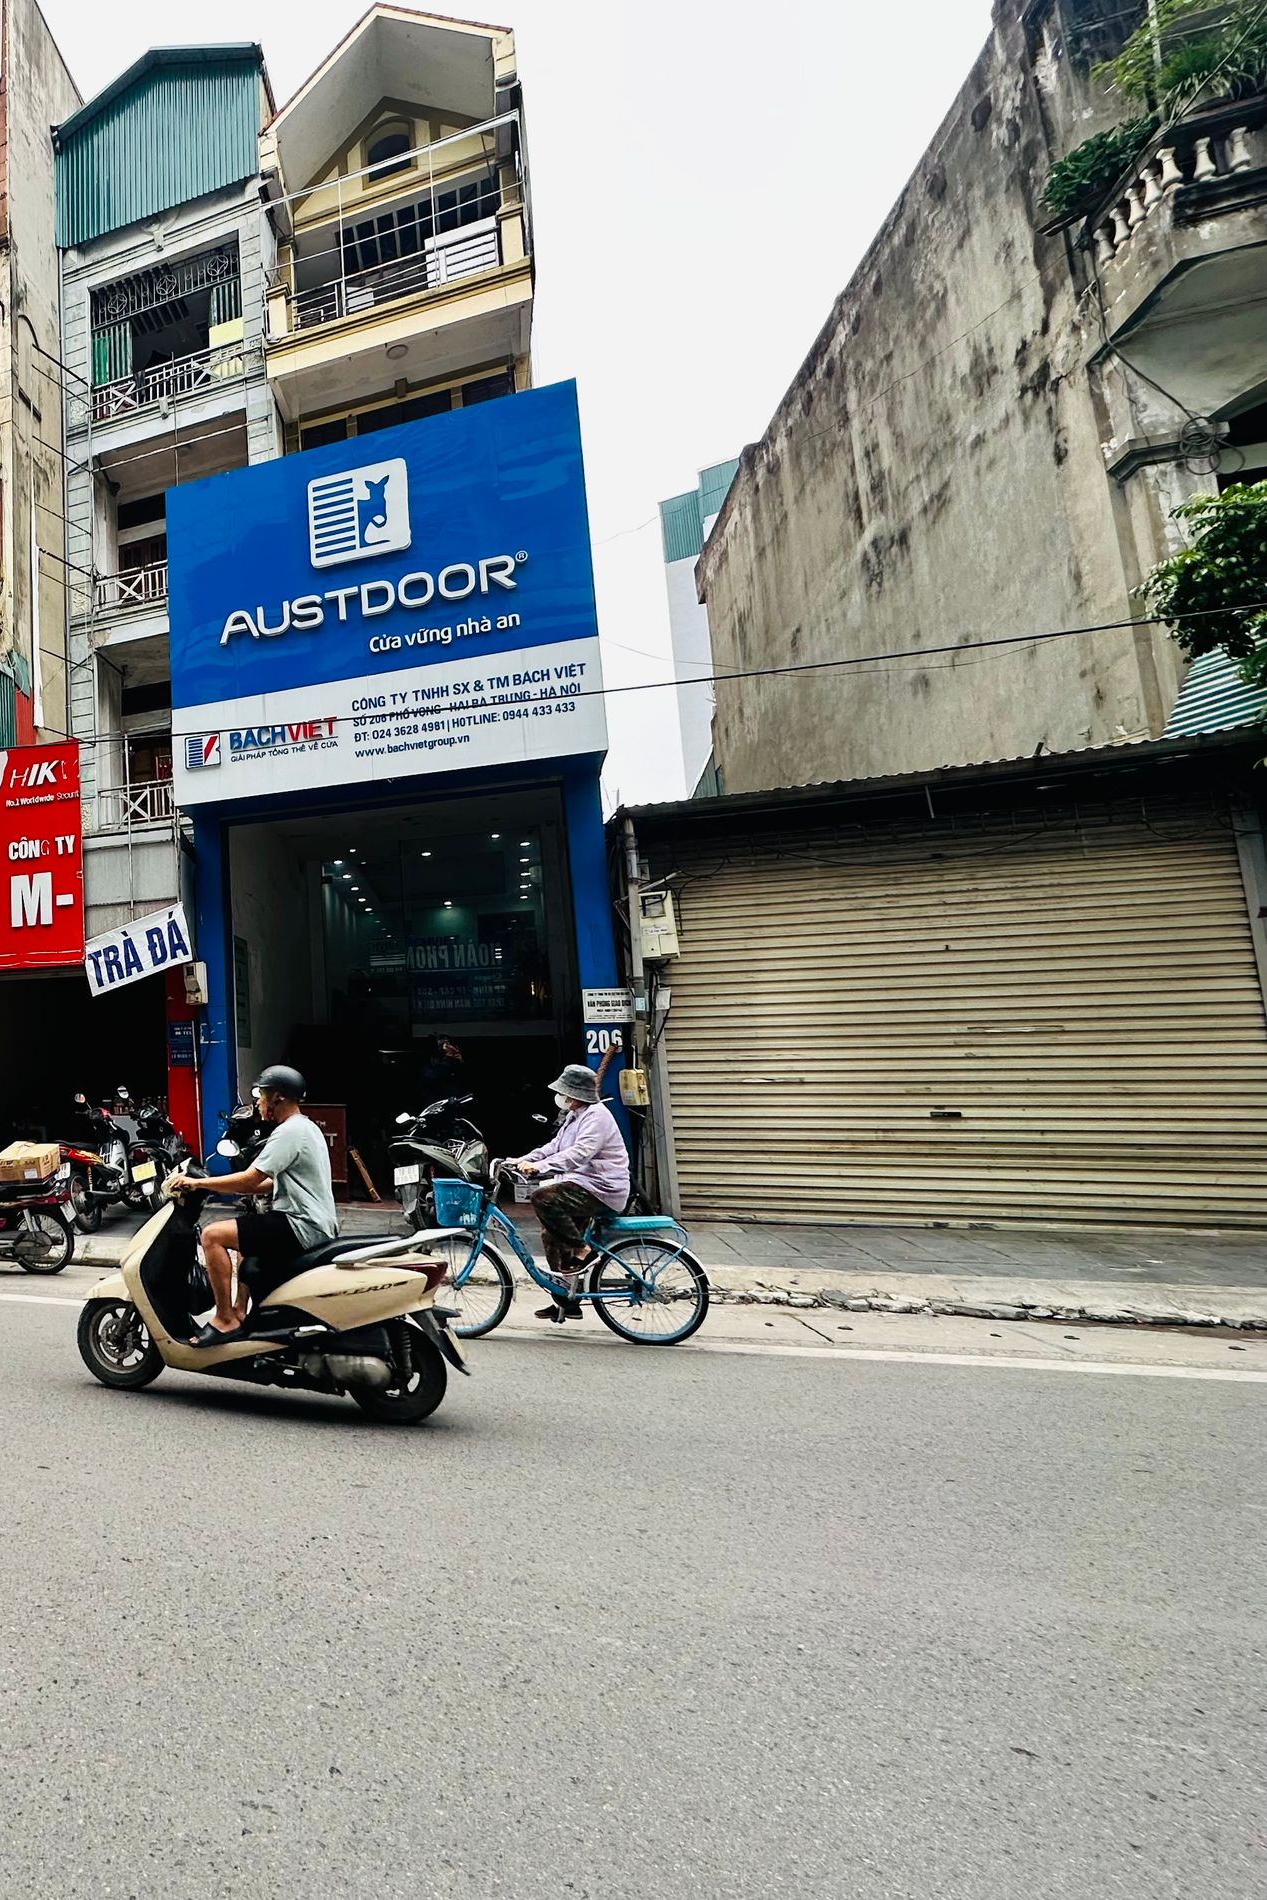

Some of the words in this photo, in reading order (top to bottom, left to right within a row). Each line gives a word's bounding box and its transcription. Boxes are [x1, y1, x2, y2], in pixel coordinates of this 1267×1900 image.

[369, 630, 402, 653] Cửa
[405, 624, 453, 646] vững
[457, 615, 492, 638] nhà
[497, 612, 521, 630] an
[351, 696, 386, 712] CÔNG
[390, 691, 408, 705] TY
[412, 685, 449, 700] TNHH
[452, 682, 471, 695] SX
[473, 679, 485, 692] &
[487, 675, 510, 689] TM
[372, 728, 392, 740] 024
[394, 724, 419, 737] 3628
[421, 720, 445, 733] 4981
[452, 712, 501, 728] HOTLINE:
[502, 708, 529, 721] 0944
[532, 705, 553, 717] 433
[555, 702, 575, 713] 433
[354, 735, 471, 758] www.bachvietgroup.vn
[55, 834, 76, 857] TY
[87, 930, 144, 988] TRÀ
[145, 911, 189, 967] ĐÁ
[586, 1029, 623, 1054] 206
